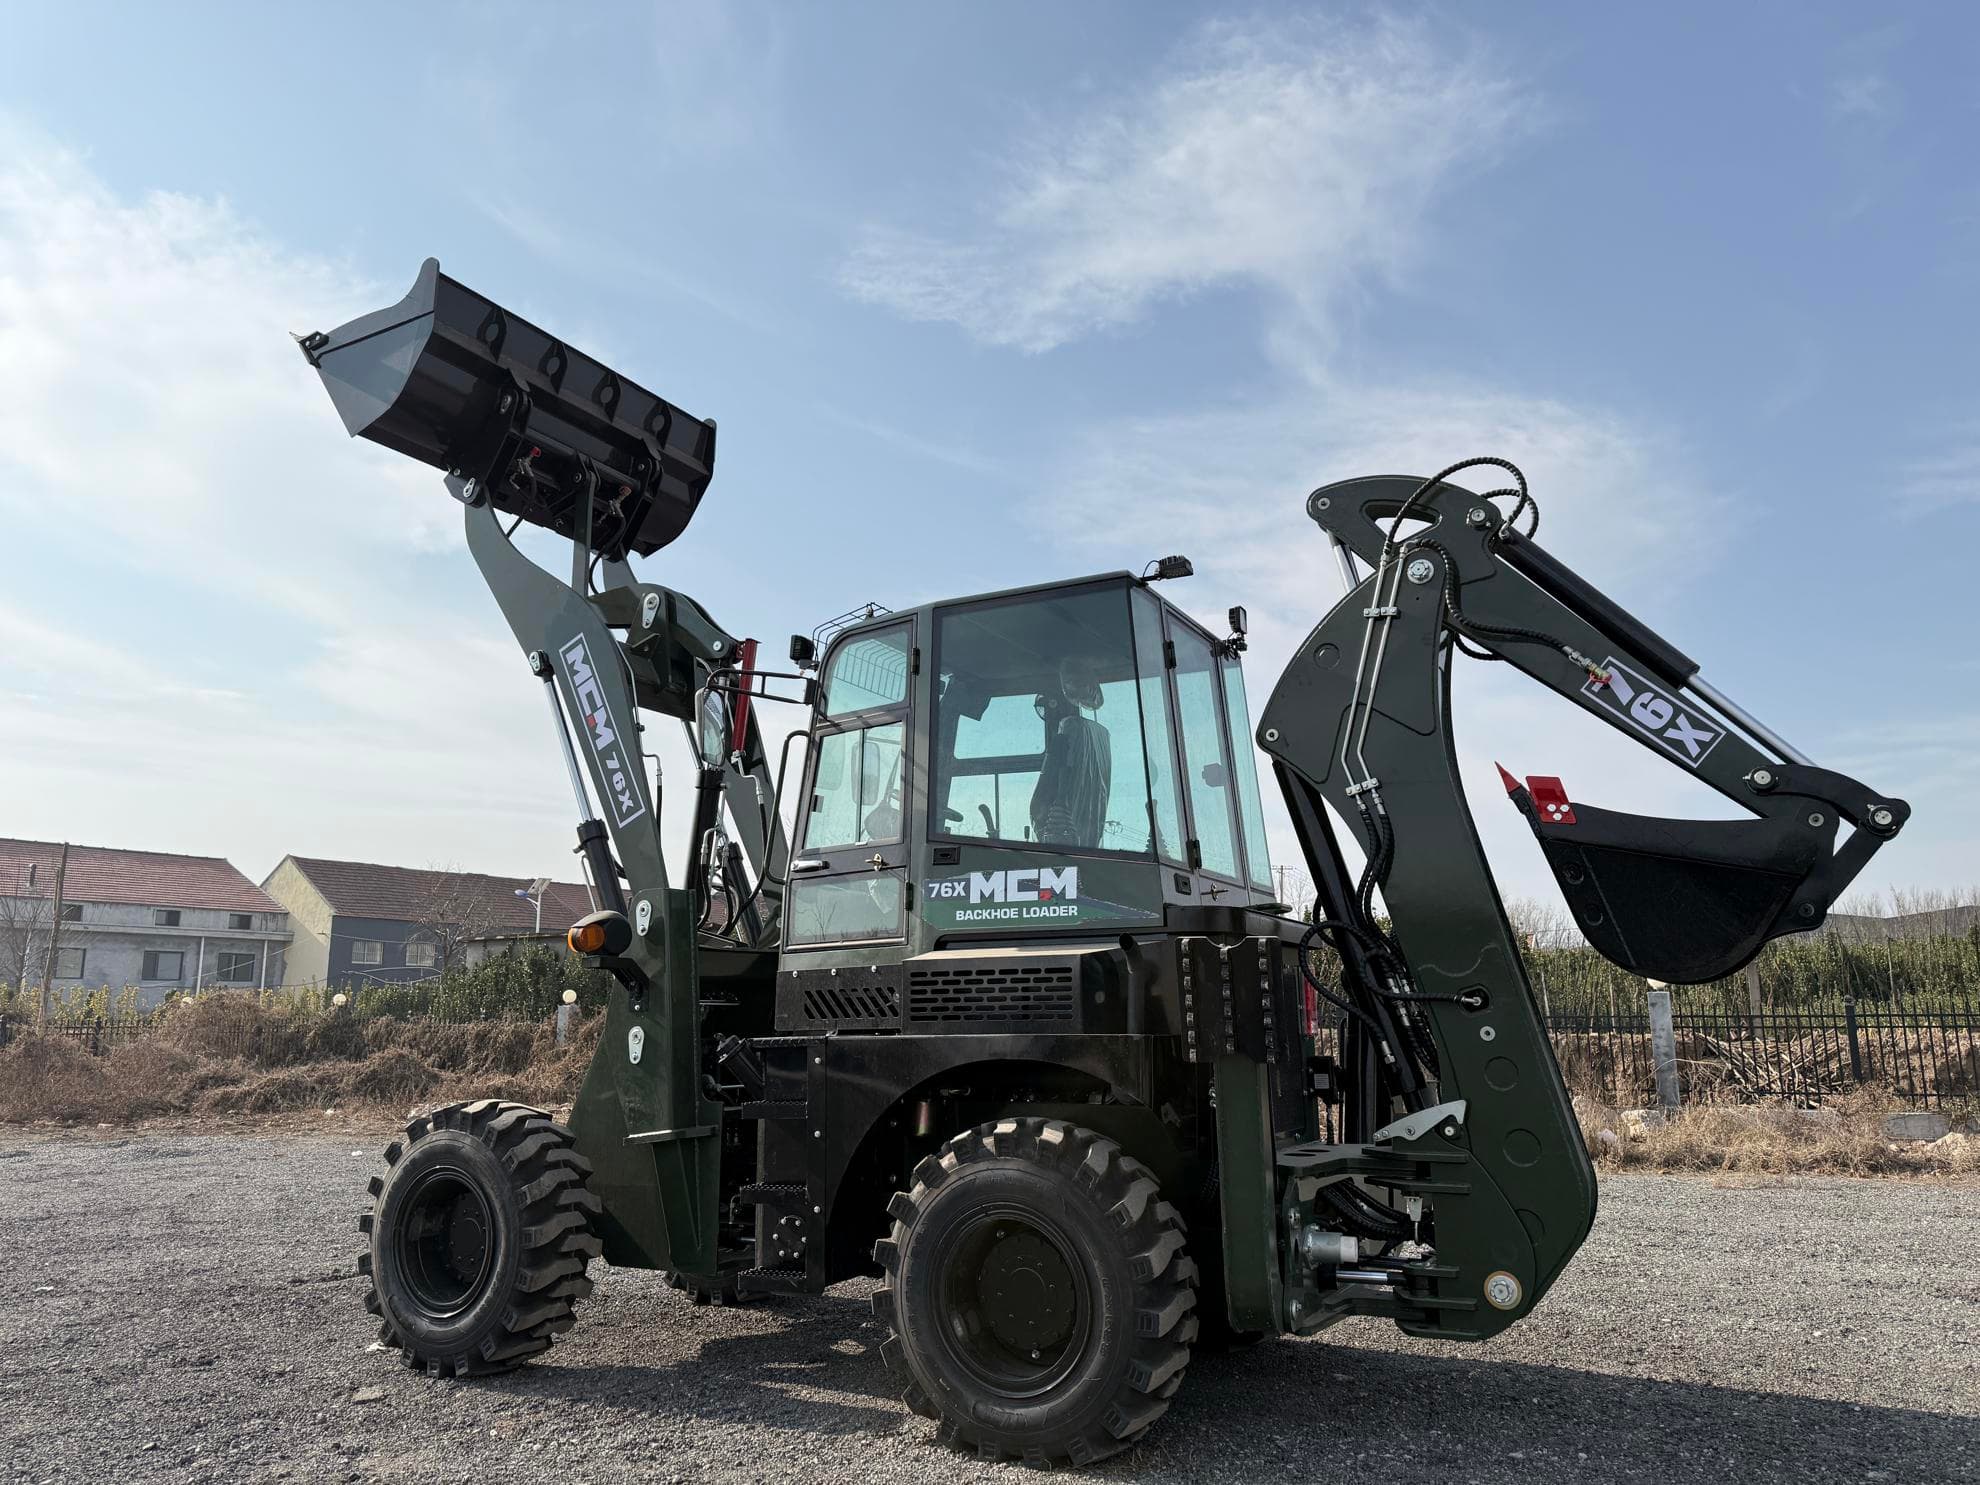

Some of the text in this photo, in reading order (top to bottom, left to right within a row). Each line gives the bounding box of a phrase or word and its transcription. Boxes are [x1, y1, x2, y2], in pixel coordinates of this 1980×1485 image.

[565, 643, 634, 814] MCM 76X
[1591, 665, 1715, 759] 76X
[928, 866, 1078, 904] 76X MCM
[955, 905, 1078, 921] BACKHOE LOADER
